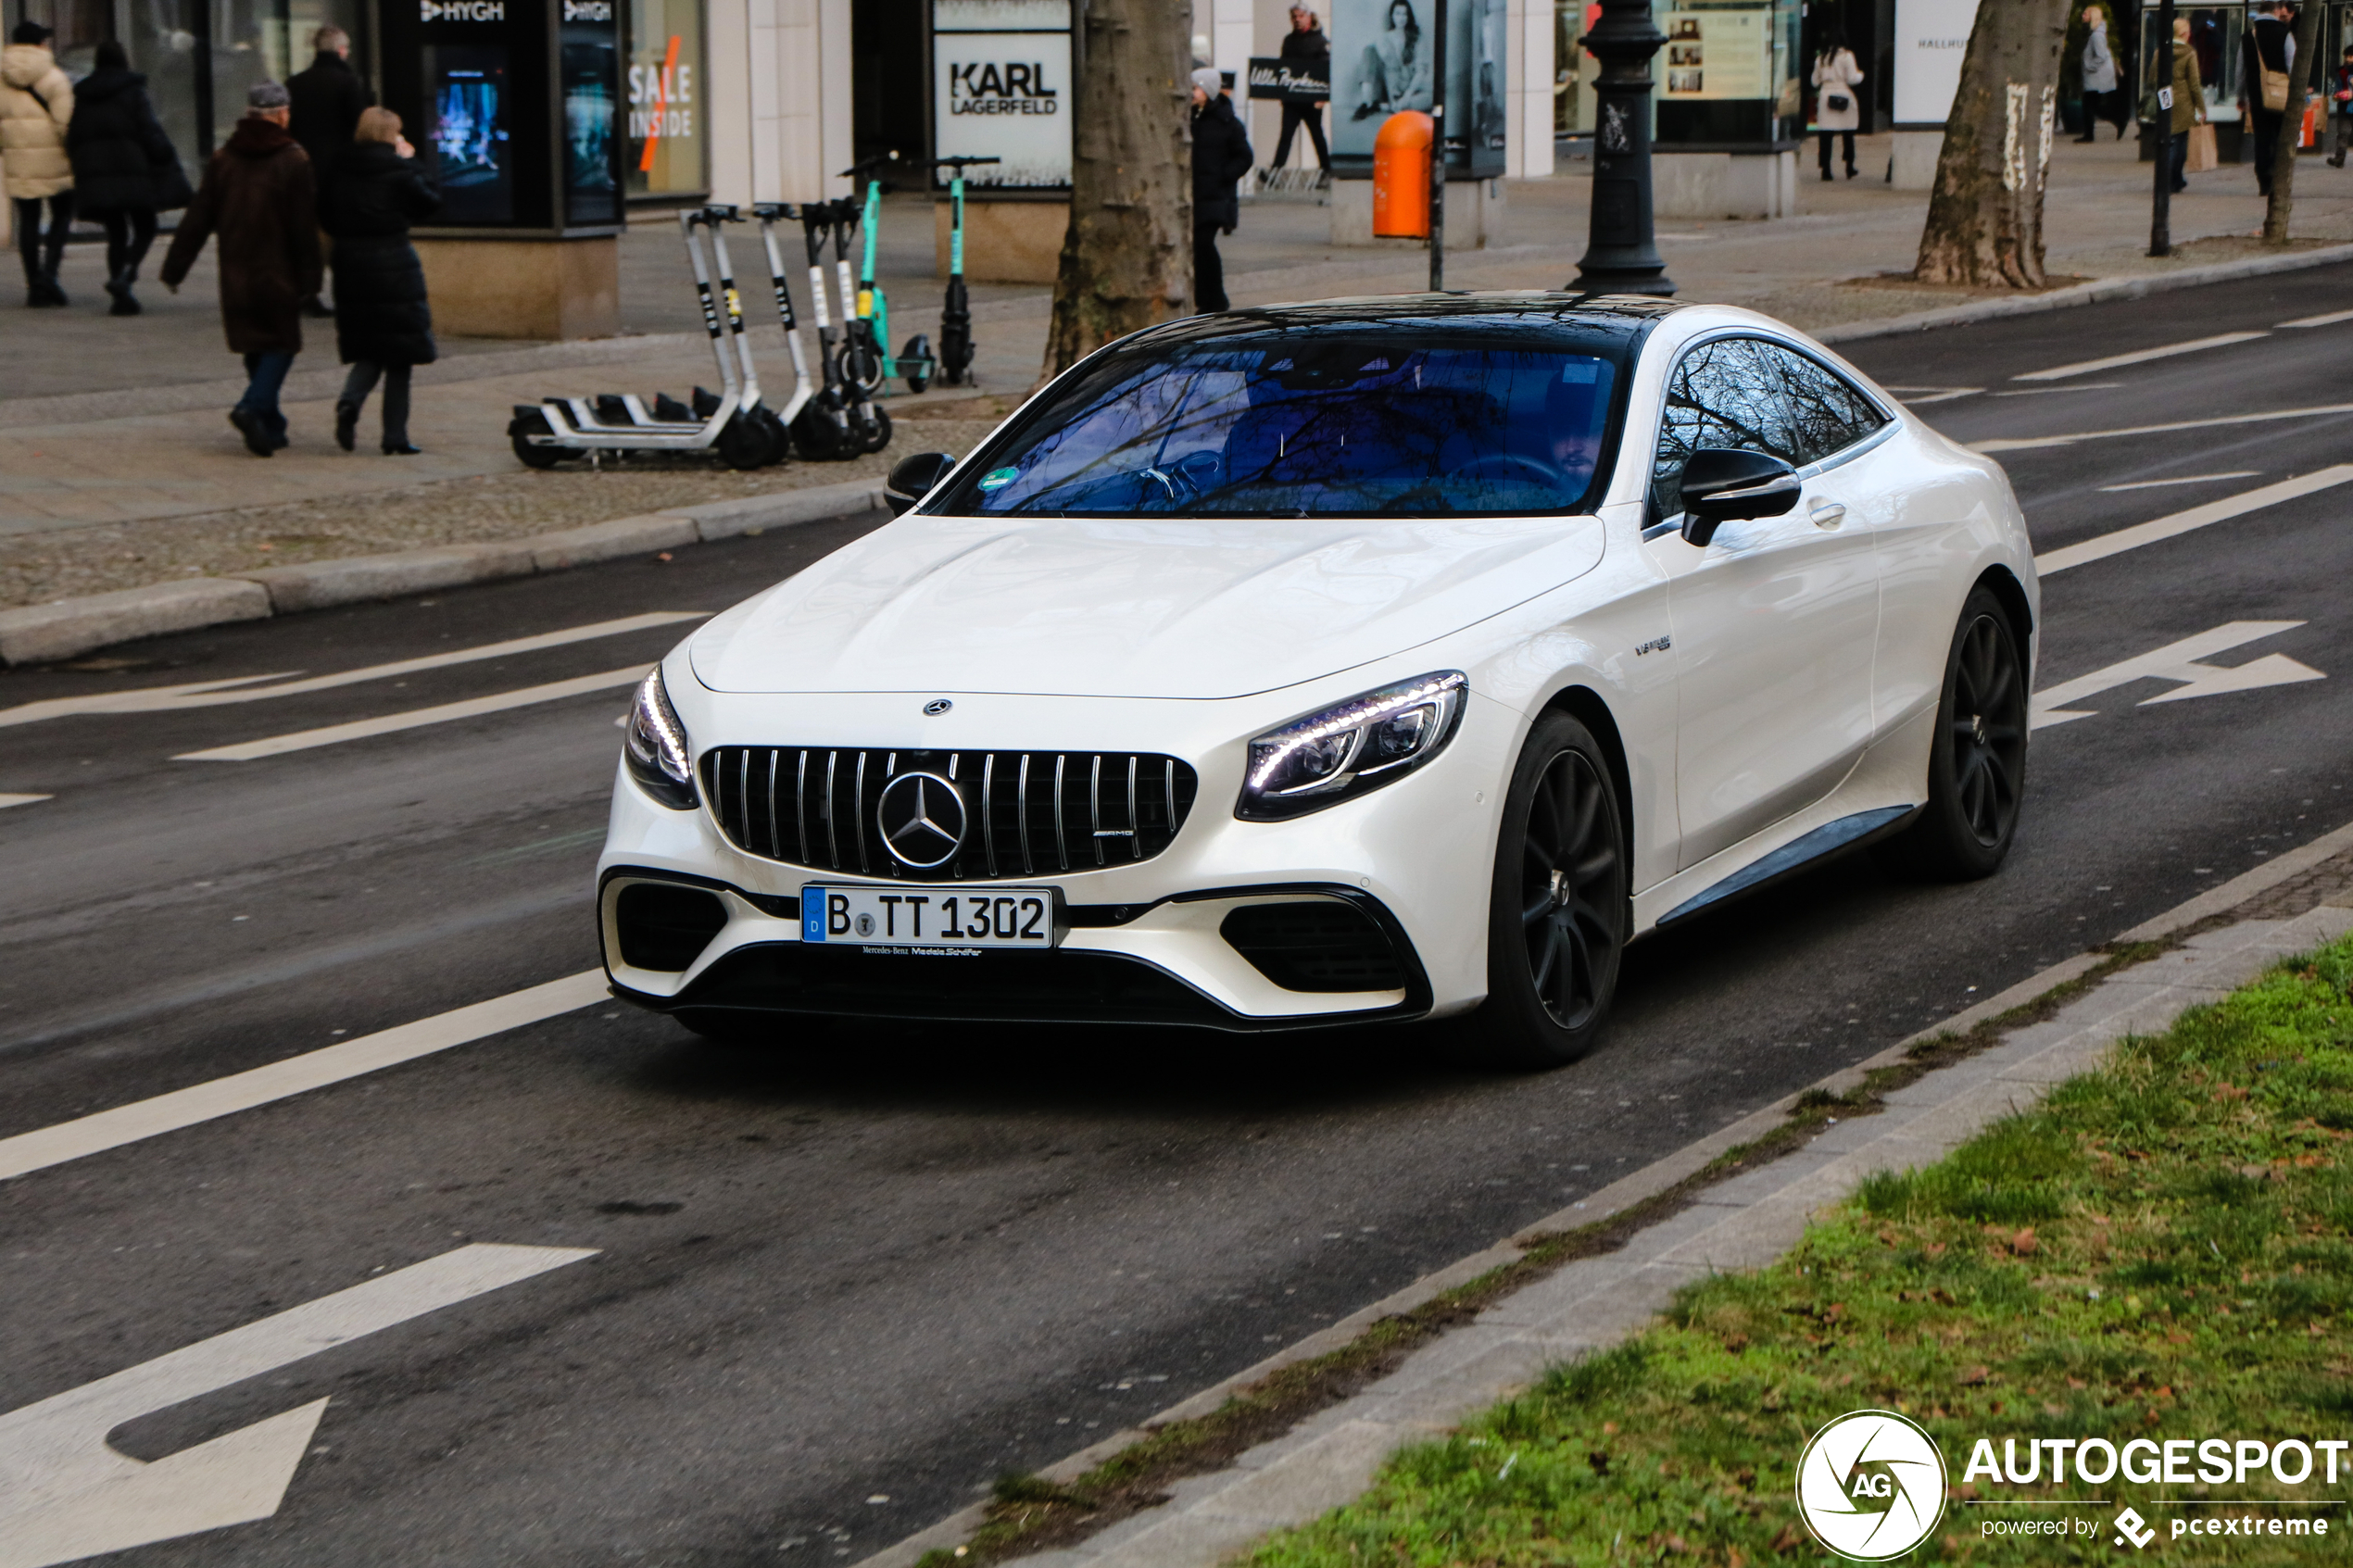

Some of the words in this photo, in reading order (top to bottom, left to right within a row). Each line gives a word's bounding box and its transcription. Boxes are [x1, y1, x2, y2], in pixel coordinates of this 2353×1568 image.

[444, 2, 505, 20] HYGH
[1919, 40, 1969, 49] HALLHU
[628, 65, 691, 103] SALE
[950, 63, 1057, 97] KARL
[951, 99, 1057, 115] LAGERFELD
[629, 111, 691, 138] INSIDE
[828, 894, 851, 935] B
[879, 896, 929, 937] TT
[941, 897, 1044, 939] 1302
[811, 921, 819, 932] D
[862, 946, 909, 955] Mercedes-Benz
